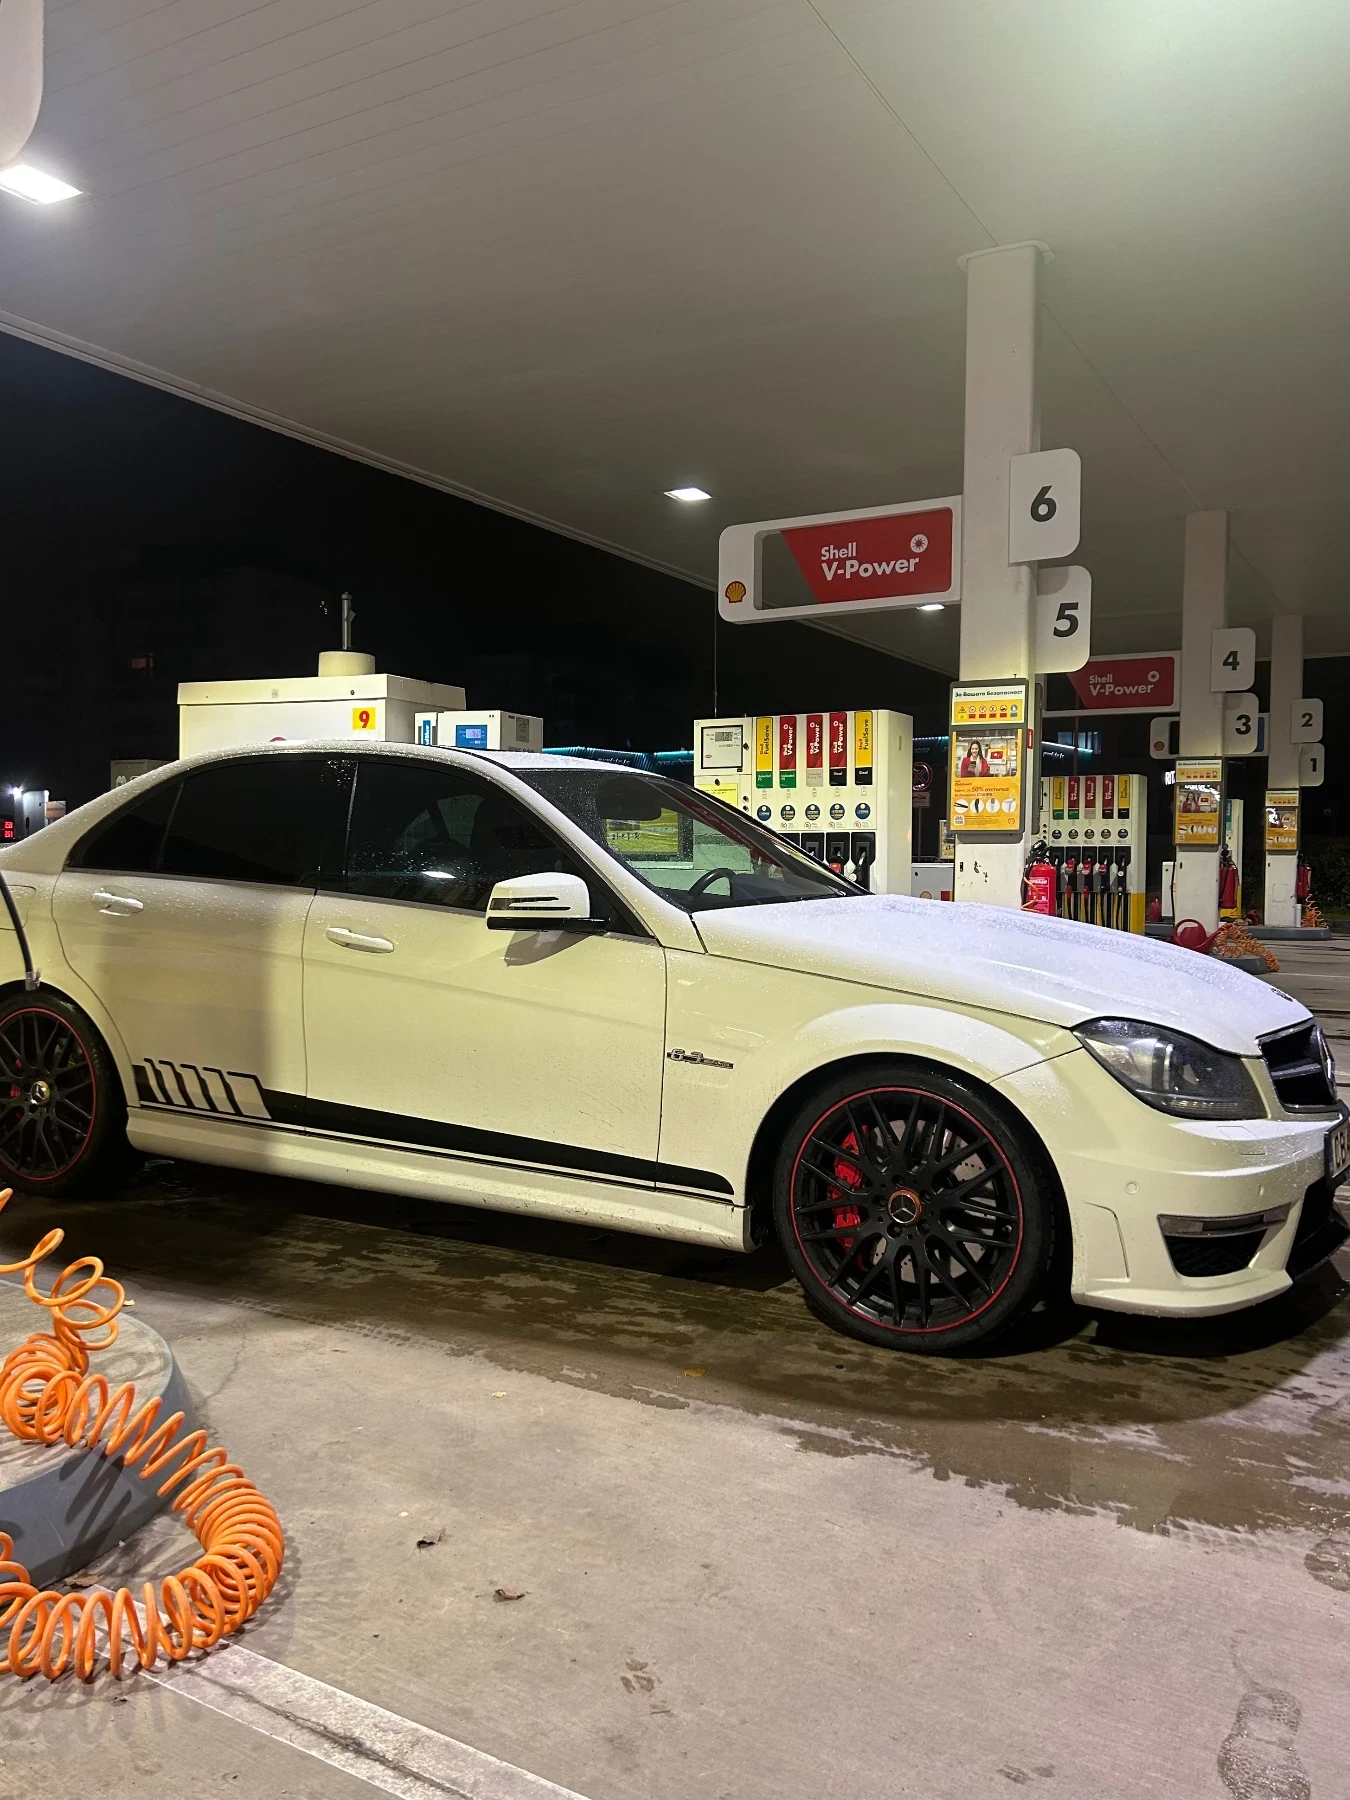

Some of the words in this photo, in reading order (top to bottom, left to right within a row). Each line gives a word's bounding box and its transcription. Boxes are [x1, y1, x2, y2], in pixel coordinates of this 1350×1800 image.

[1031, 485, 1057, 522] 6
[821, 542, 857, 560] Shell
[821, 557, 920, 581] V-Power
[1053, 602, 1079, 638] 5
[1222, 650, 1240, 671] 4
[1089, 674, 1113, 684] Shell
[1089, 683, 1154, 696] V-Power
[358, 710, 371, 729] 9
[1235, 714, 1252, 735] 3
[1301, 712, 1313, 728] 2
[1310, 758, 1318, 773] 1
